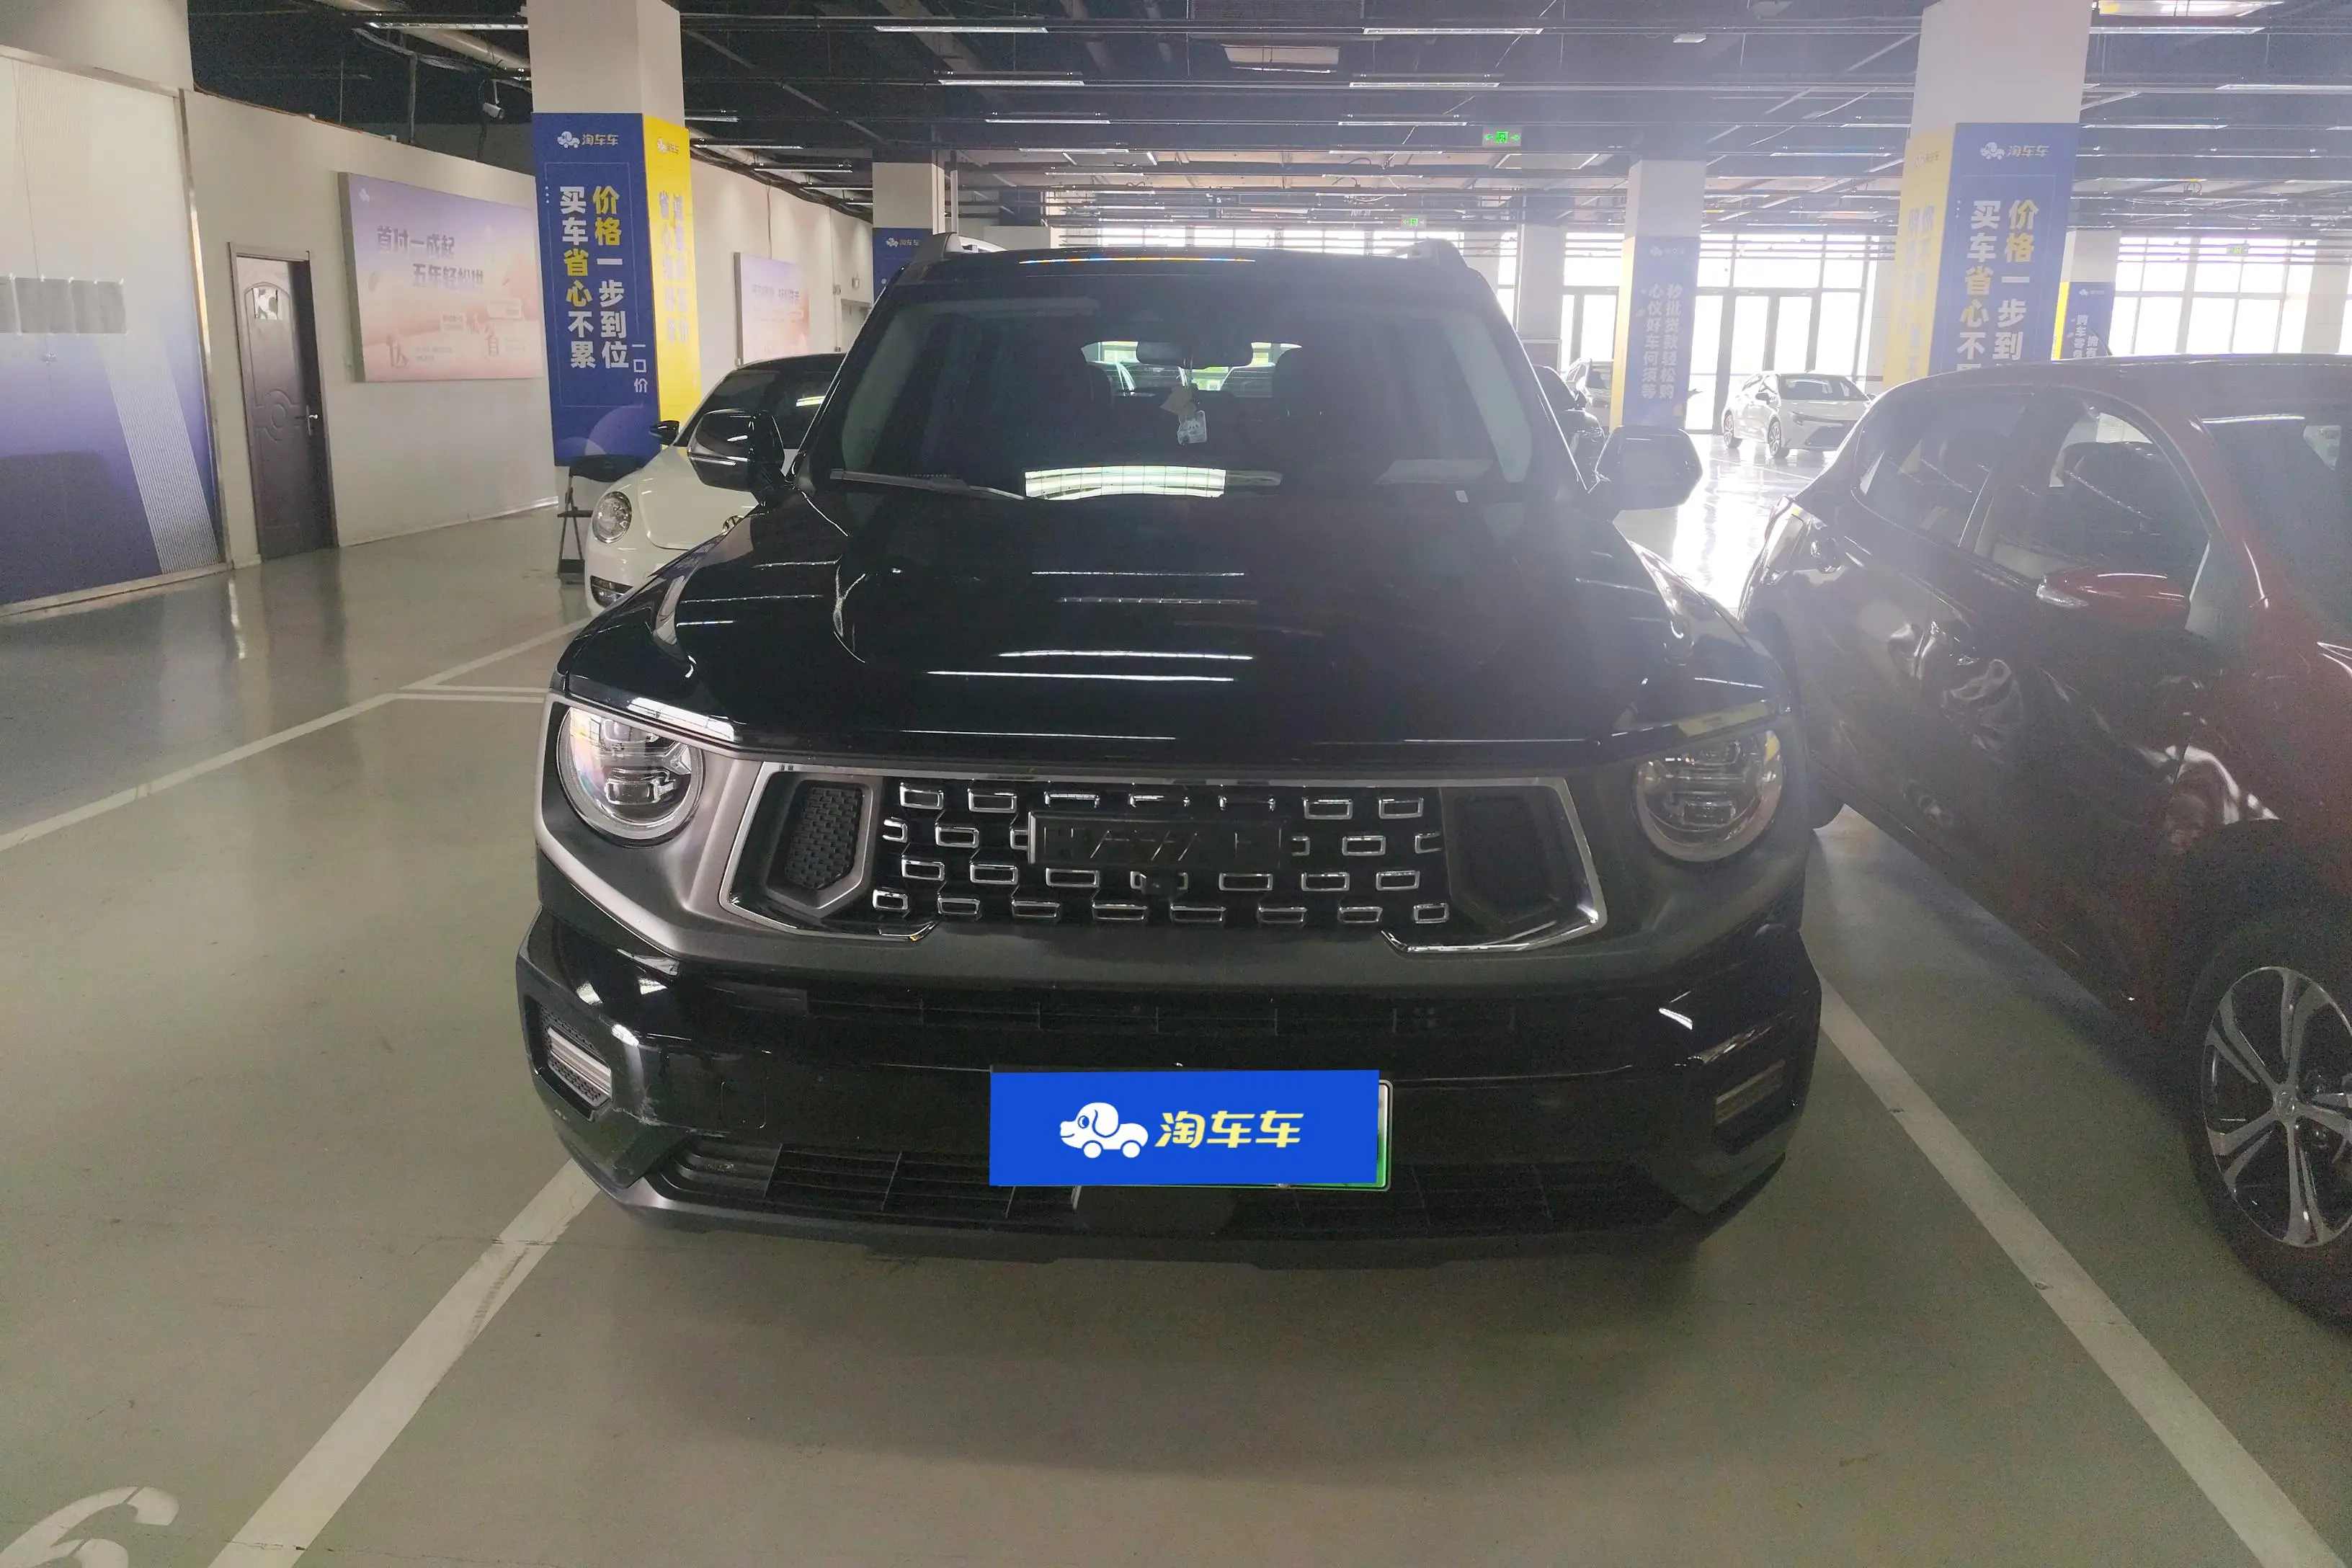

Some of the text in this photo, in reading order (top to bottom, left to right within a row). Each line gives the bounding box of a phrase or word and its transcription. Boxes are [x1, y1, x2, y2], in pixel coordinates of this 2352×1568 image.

[582, 133, 618, 146] 淘车车
[2008, 145, 2049, 157] 淘车车
[559, 186, 597, 369] 买车省心不累
[592, 185, 629, 369] 价格一步到位
[1956, 200, 2001, 371] 买车省心不
[1992, 199, 2039, 360] 价格一步到
[631, 344, 649, 393] 一口价
[1642, 283, 1664, 400] 心仪好车何须等
[1659, 283, 1683, 399] 秒批贷款轻松购
